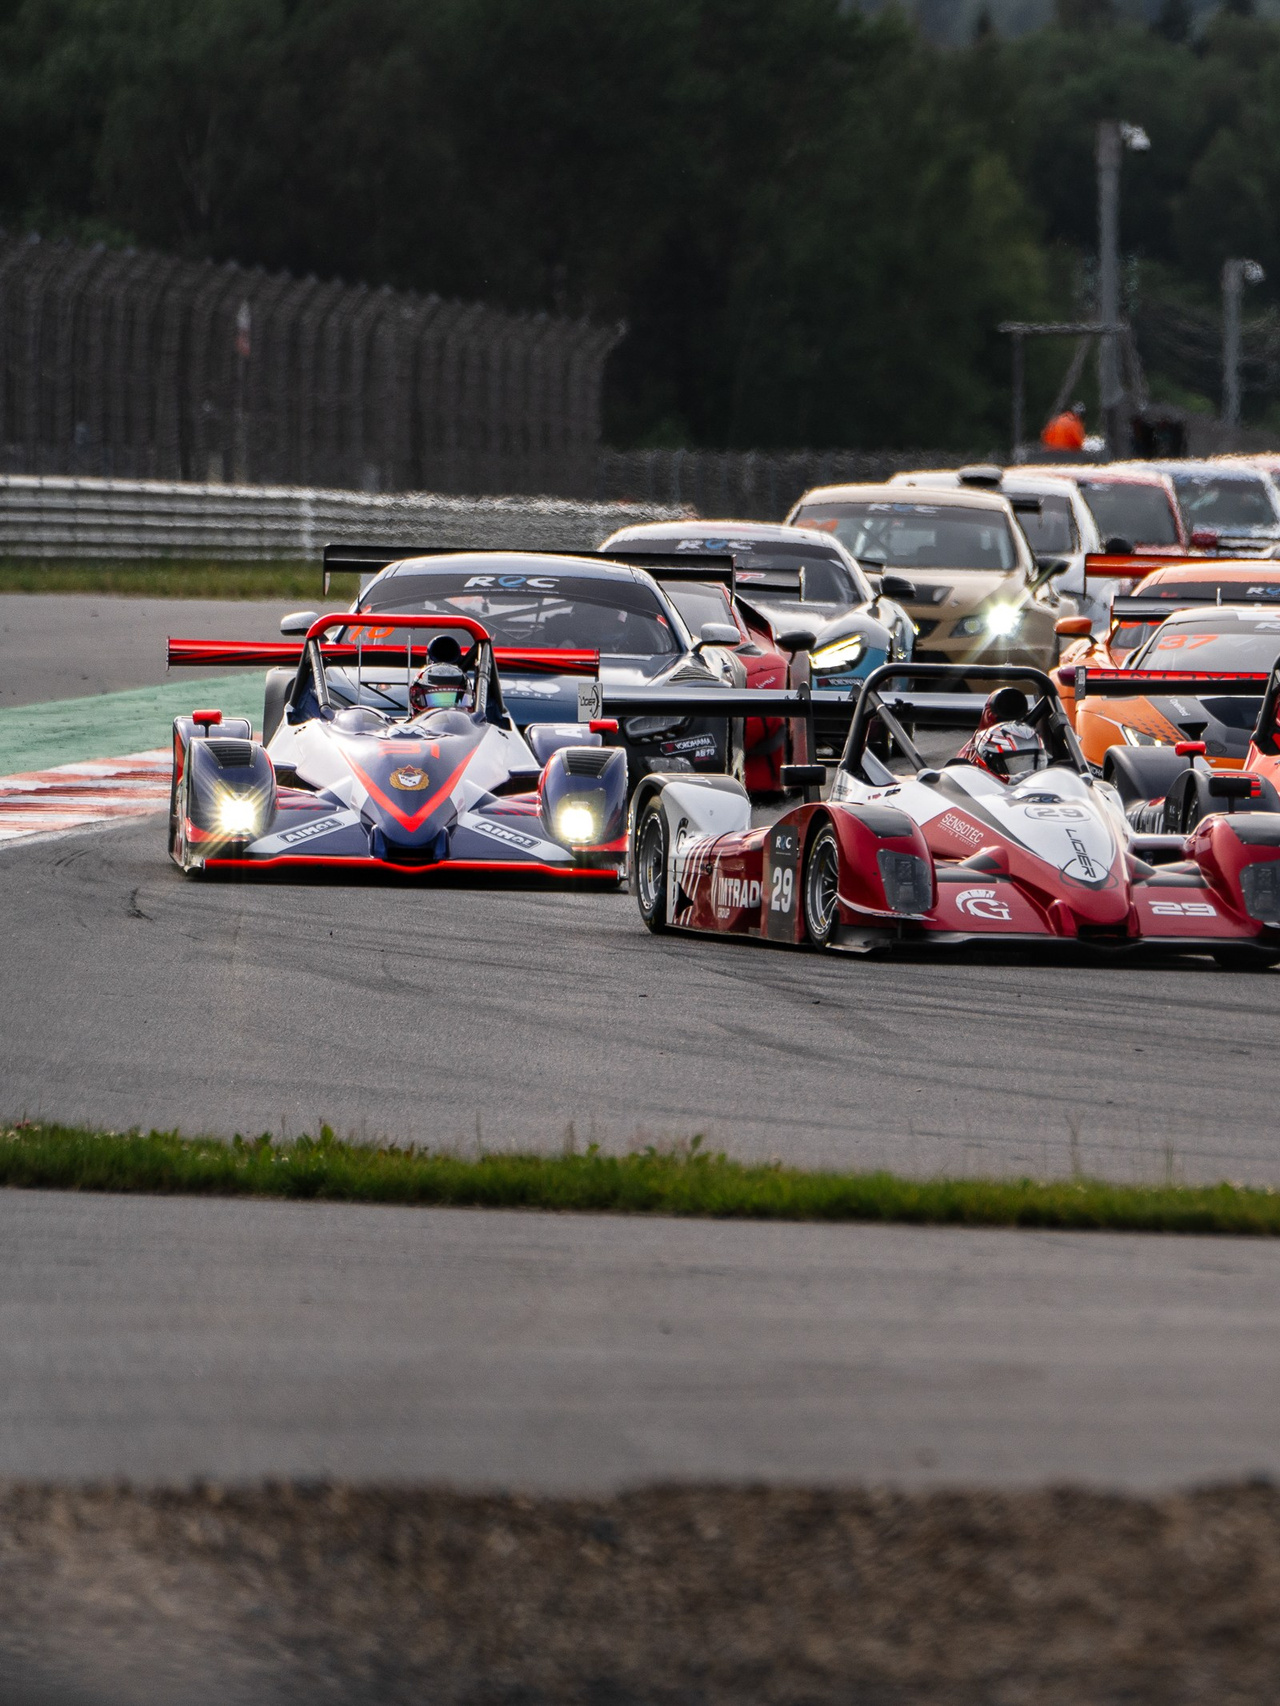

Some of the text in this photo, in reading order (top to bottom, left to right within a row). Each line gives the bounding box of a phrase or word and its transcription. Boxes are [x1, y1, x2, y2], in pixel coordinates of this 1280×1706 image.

[1157, 634, 1219, 650] 37
[941, 813, 984, 843] SENSOTEC
[1033, 808, 1084, 818] 29
[1065, 828, 1097, 878] LIGIER
[717, 877, 763, 909] IMTRAD
[771, 867, 793, 913] 29
[1148, 901, 1217, 917] 29
